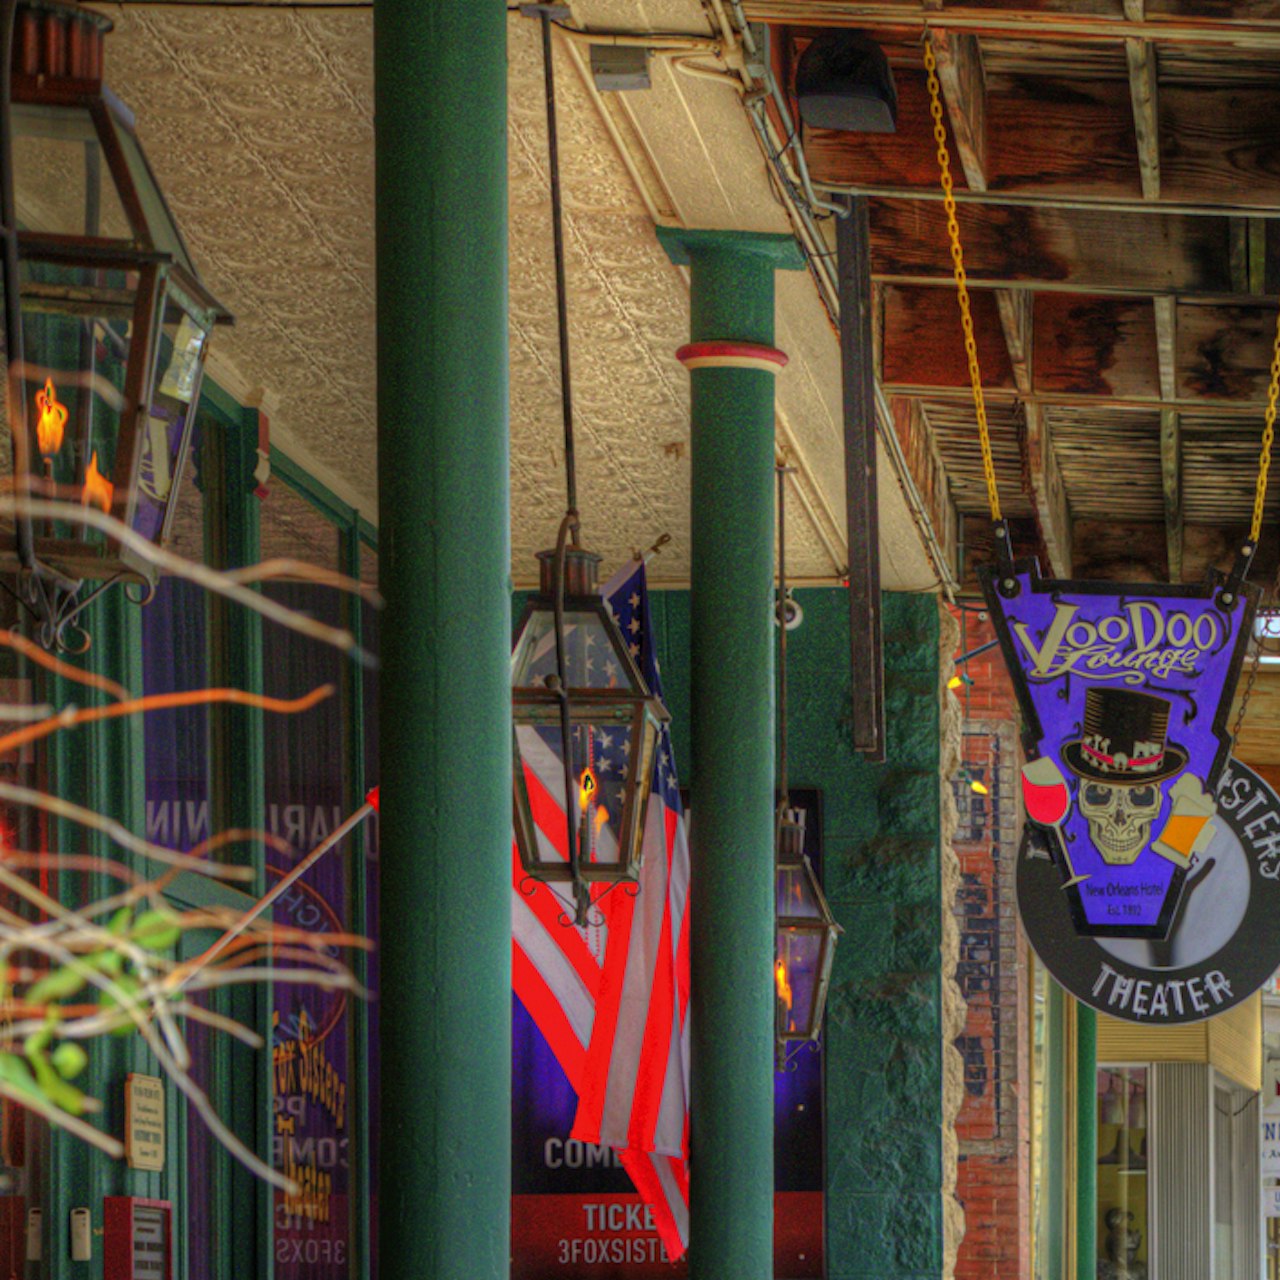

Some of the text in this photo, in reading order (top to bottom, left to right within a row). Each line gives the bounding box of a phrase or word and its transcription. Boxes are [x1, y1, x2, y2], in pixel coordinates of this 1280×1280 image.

[1030, 645, 1201, 685] Lounge
[1085, 881, 1164, 897] New Orleans Hotel
[1091, 960, 1235, 1018] THEATER
